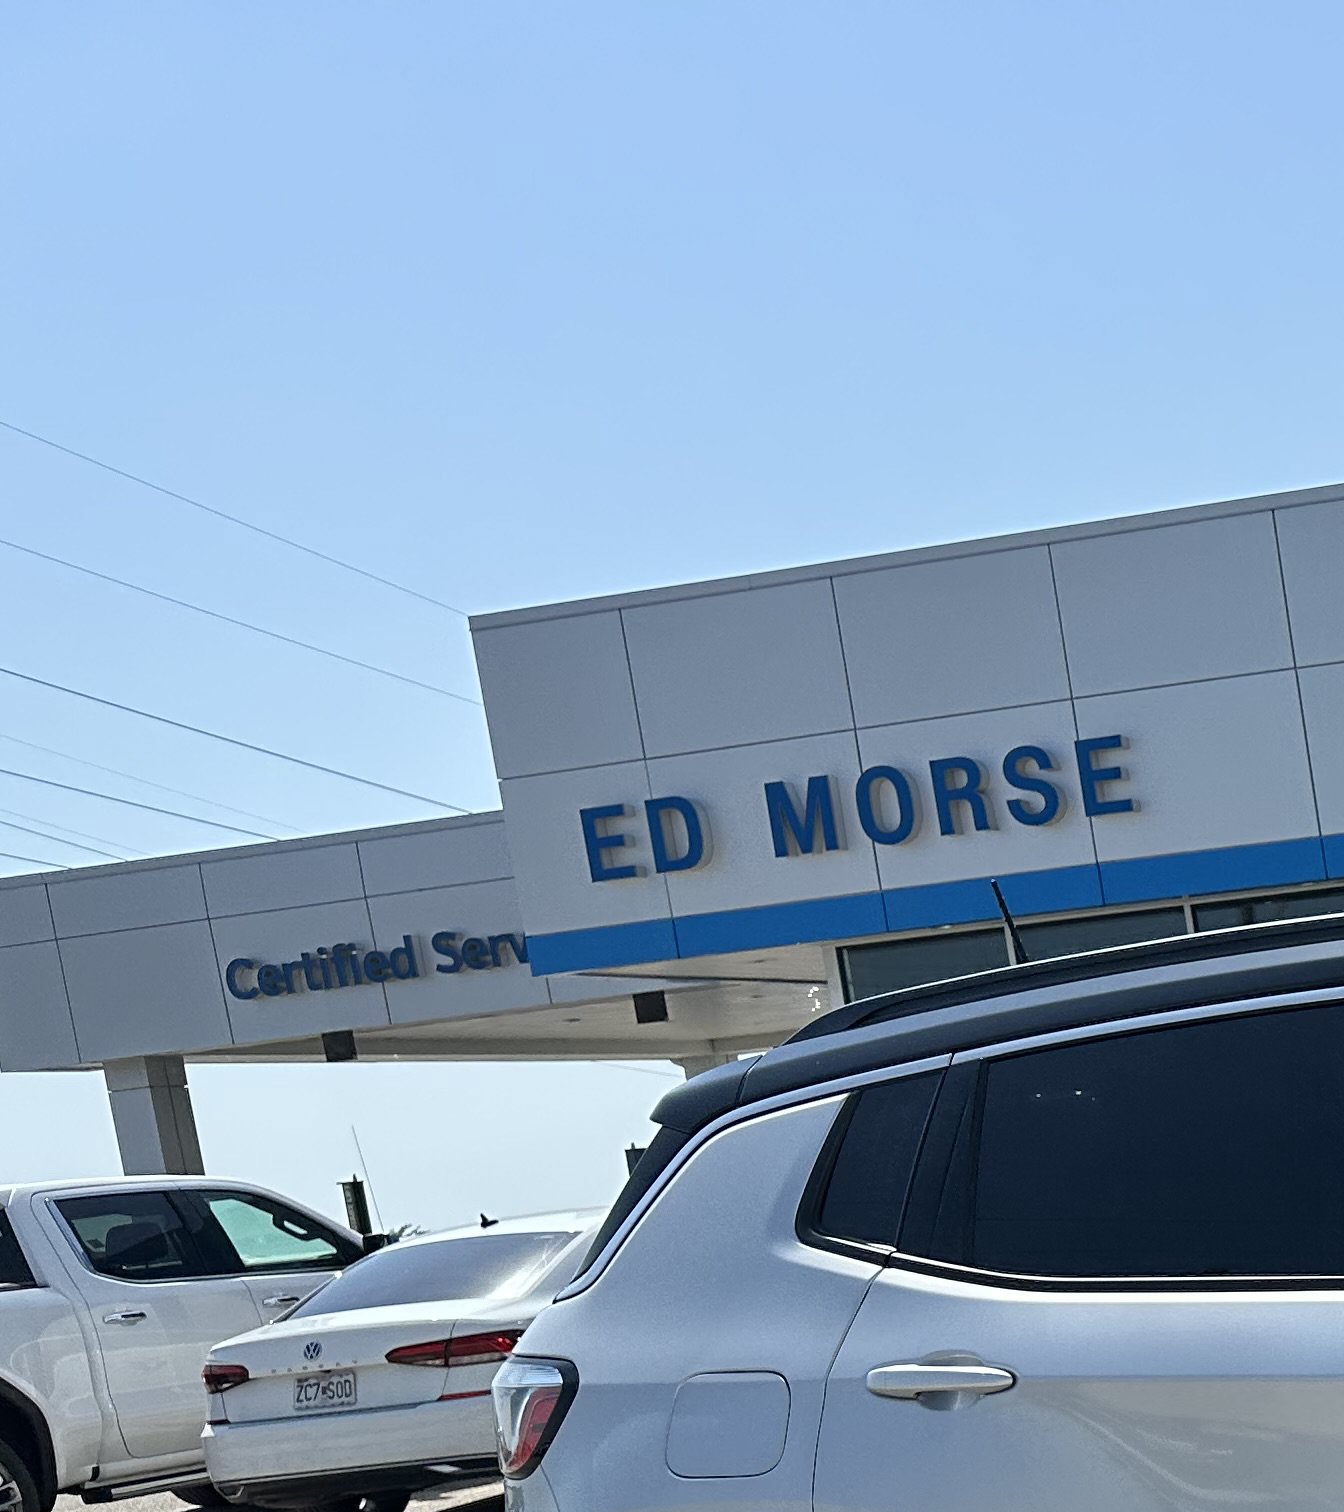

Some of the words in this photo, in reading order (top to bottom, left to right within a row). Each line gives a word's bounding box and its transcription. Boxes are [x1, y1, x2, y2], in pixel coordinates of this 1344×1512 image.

[579, 794, 703, 883] ED
[763, 734, 1133, 858] MORSE
[225, 934, 419, 1001] Certified
[296, 1383, 320, 1403] ZC7
